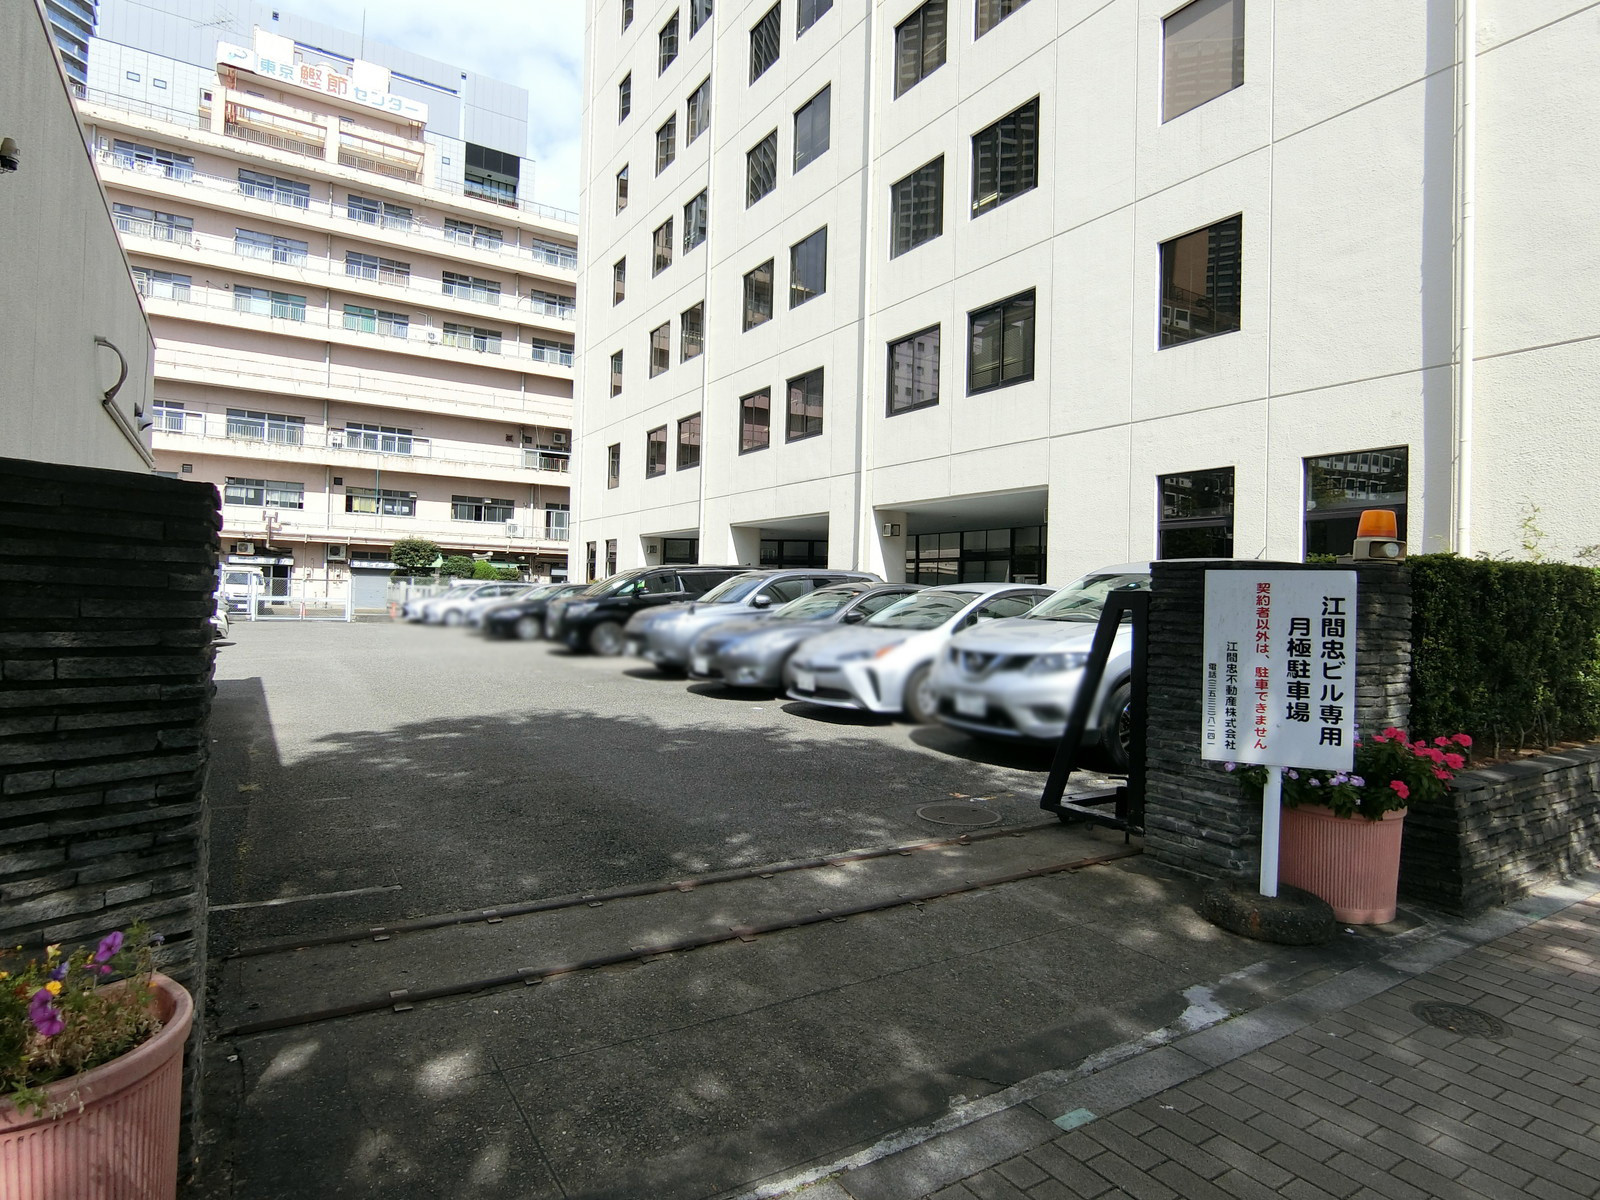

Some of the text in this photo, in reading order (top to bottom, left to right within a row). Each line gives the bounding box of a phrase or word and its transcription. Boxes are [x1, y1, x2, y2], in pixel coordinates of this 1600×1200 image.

[1225, 642, 1237, 750] 江間忠不動産株式会社
[1285, 617, 1311, 723] 月極駐車場
[1318, 595, 1346, 747] 江間忠ビル専用
